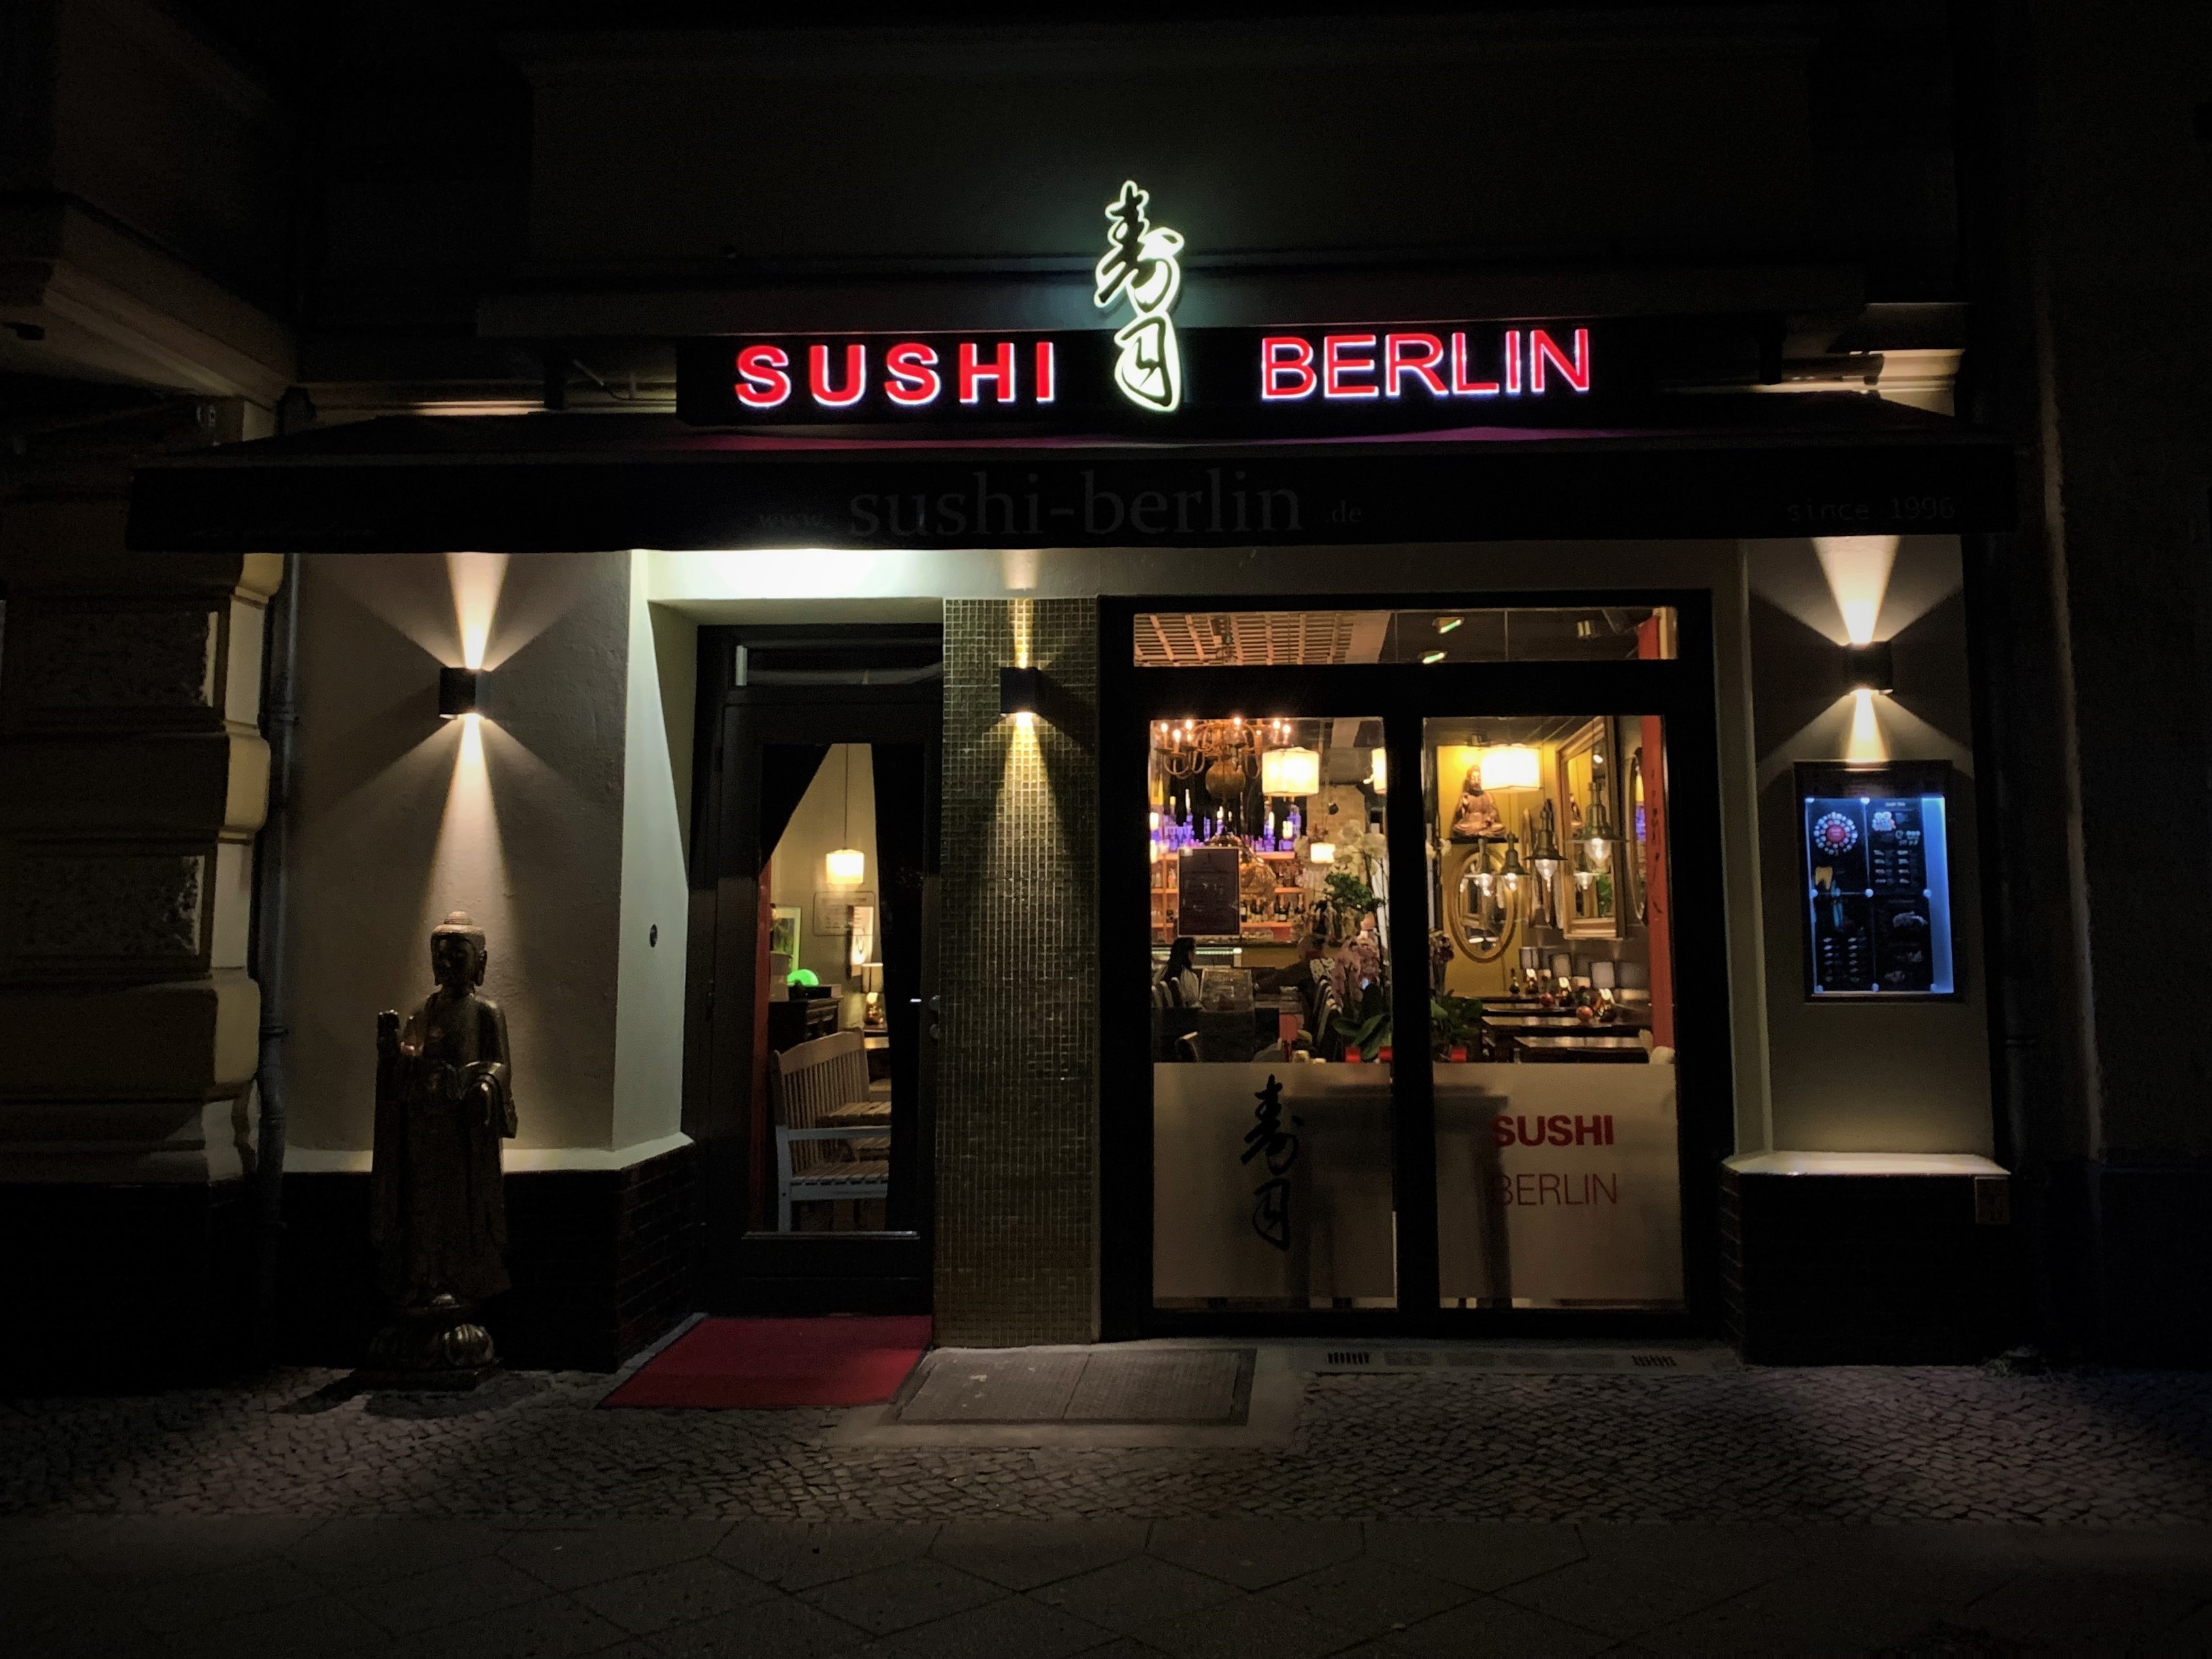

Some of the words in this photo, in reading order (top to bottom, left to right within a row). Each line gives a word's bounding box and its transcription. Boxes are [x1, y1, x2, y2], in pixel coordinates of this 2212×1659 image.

[735, 342, 1054, 406] SUSHI
[1261, 329, 1589, 399] BERLIN
[849, 468, 1303, 538] sushi-berlin
[1787, 498, 1870, 522] since
[1890, 496, 1955, 520] 1996
[1491, 1115, 1613, 1146] SUSHI
[1490, 1174, 1617, 1206] BERLIN
